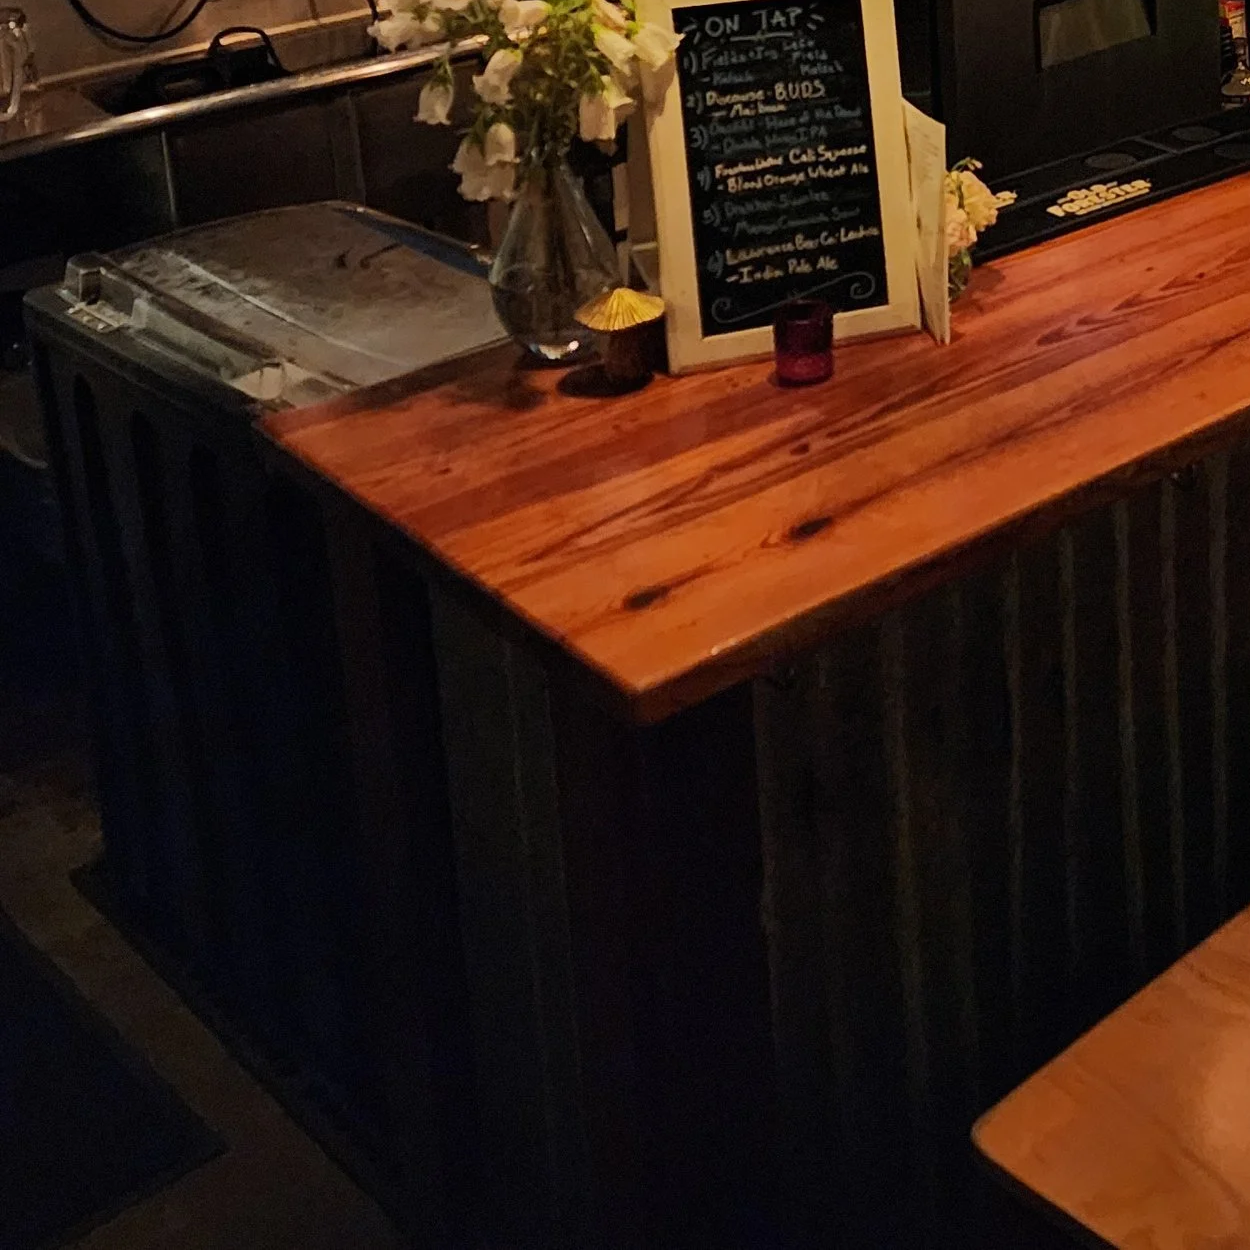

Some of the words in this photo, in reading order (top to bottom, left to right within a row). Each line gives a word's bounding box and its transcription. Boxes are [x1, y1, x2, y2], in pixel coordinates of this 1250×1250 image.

[705, 14, 740, 37] ON
[752, 6, 803, 30] TAP
[774, 79, 828, 101] BUDS
